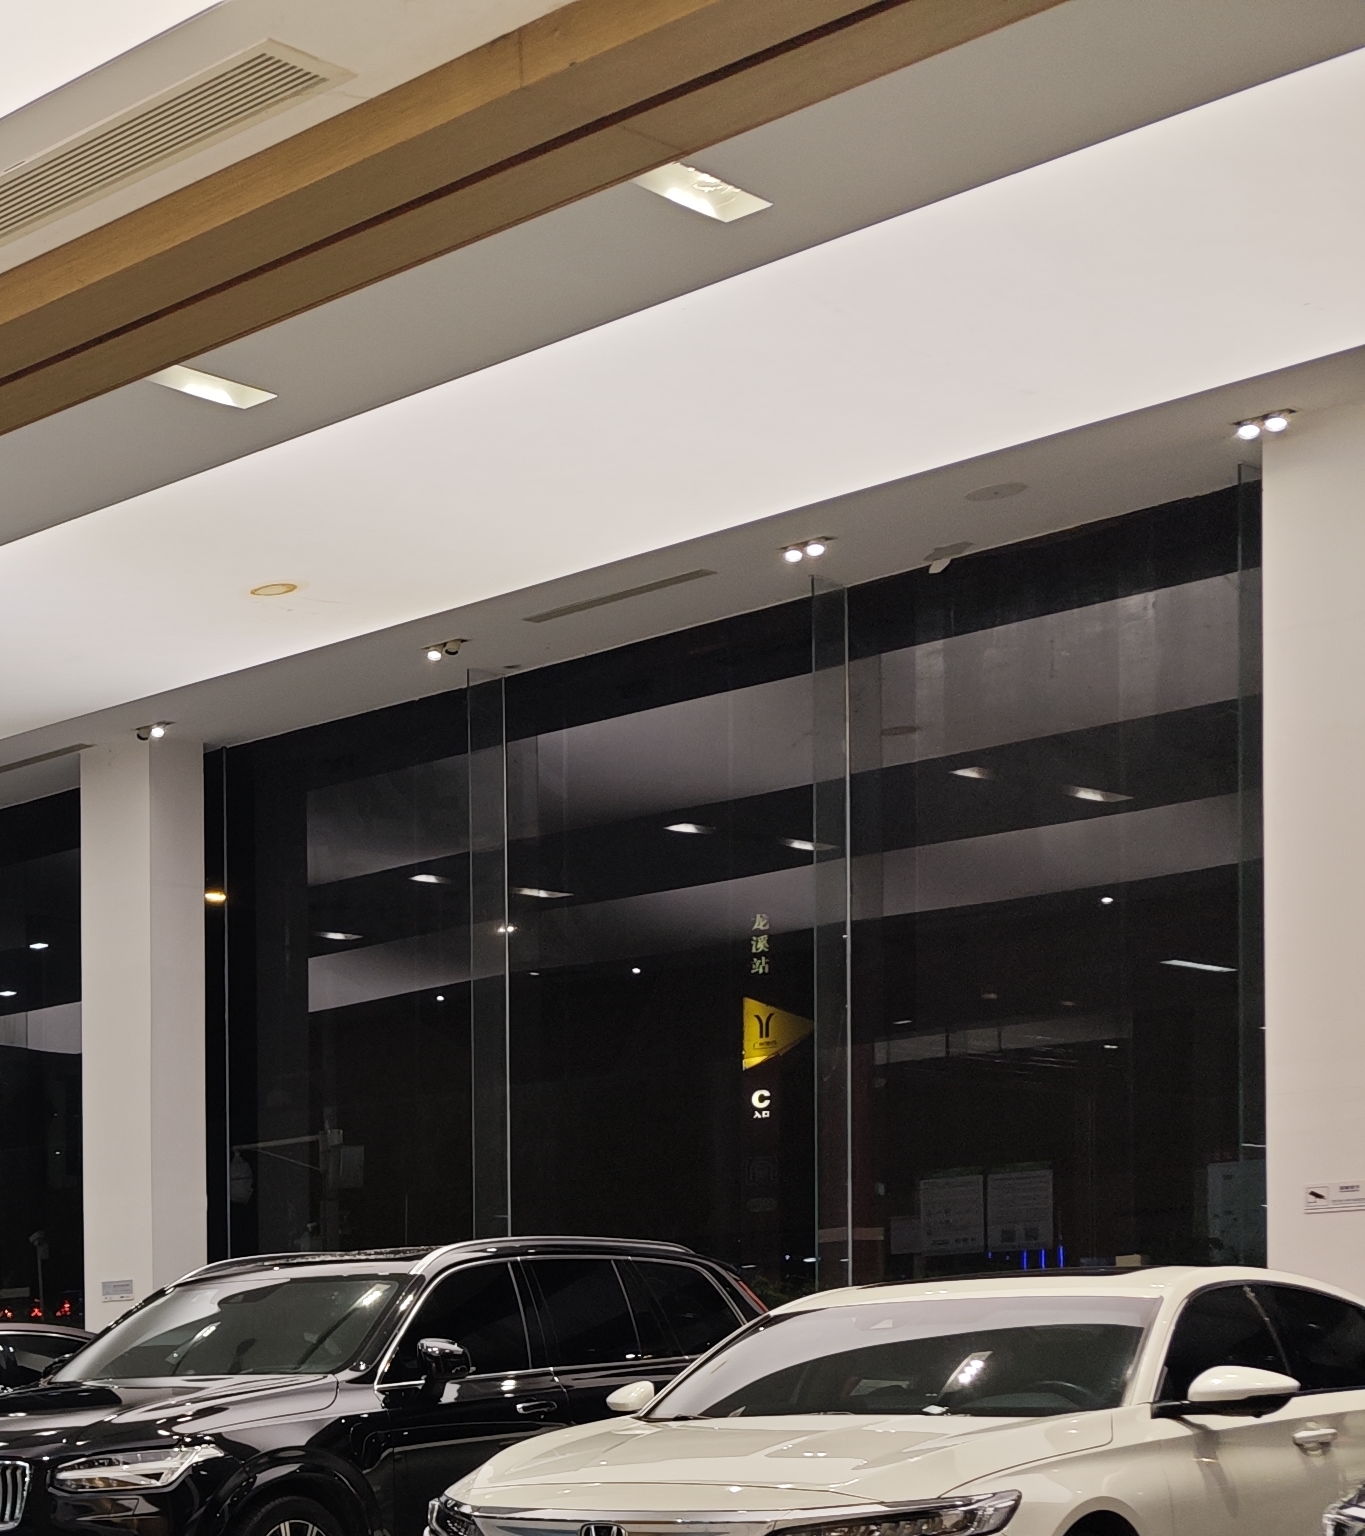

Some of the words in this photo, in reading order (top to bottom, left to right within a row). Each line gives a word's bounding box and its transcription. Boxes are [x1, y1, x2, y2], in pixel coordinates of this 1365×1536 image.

[750, 913, 770, 975] 龙溪站
[751, 1089, 771, 1108] C
[752, 1110, 771, 1119] 入口
